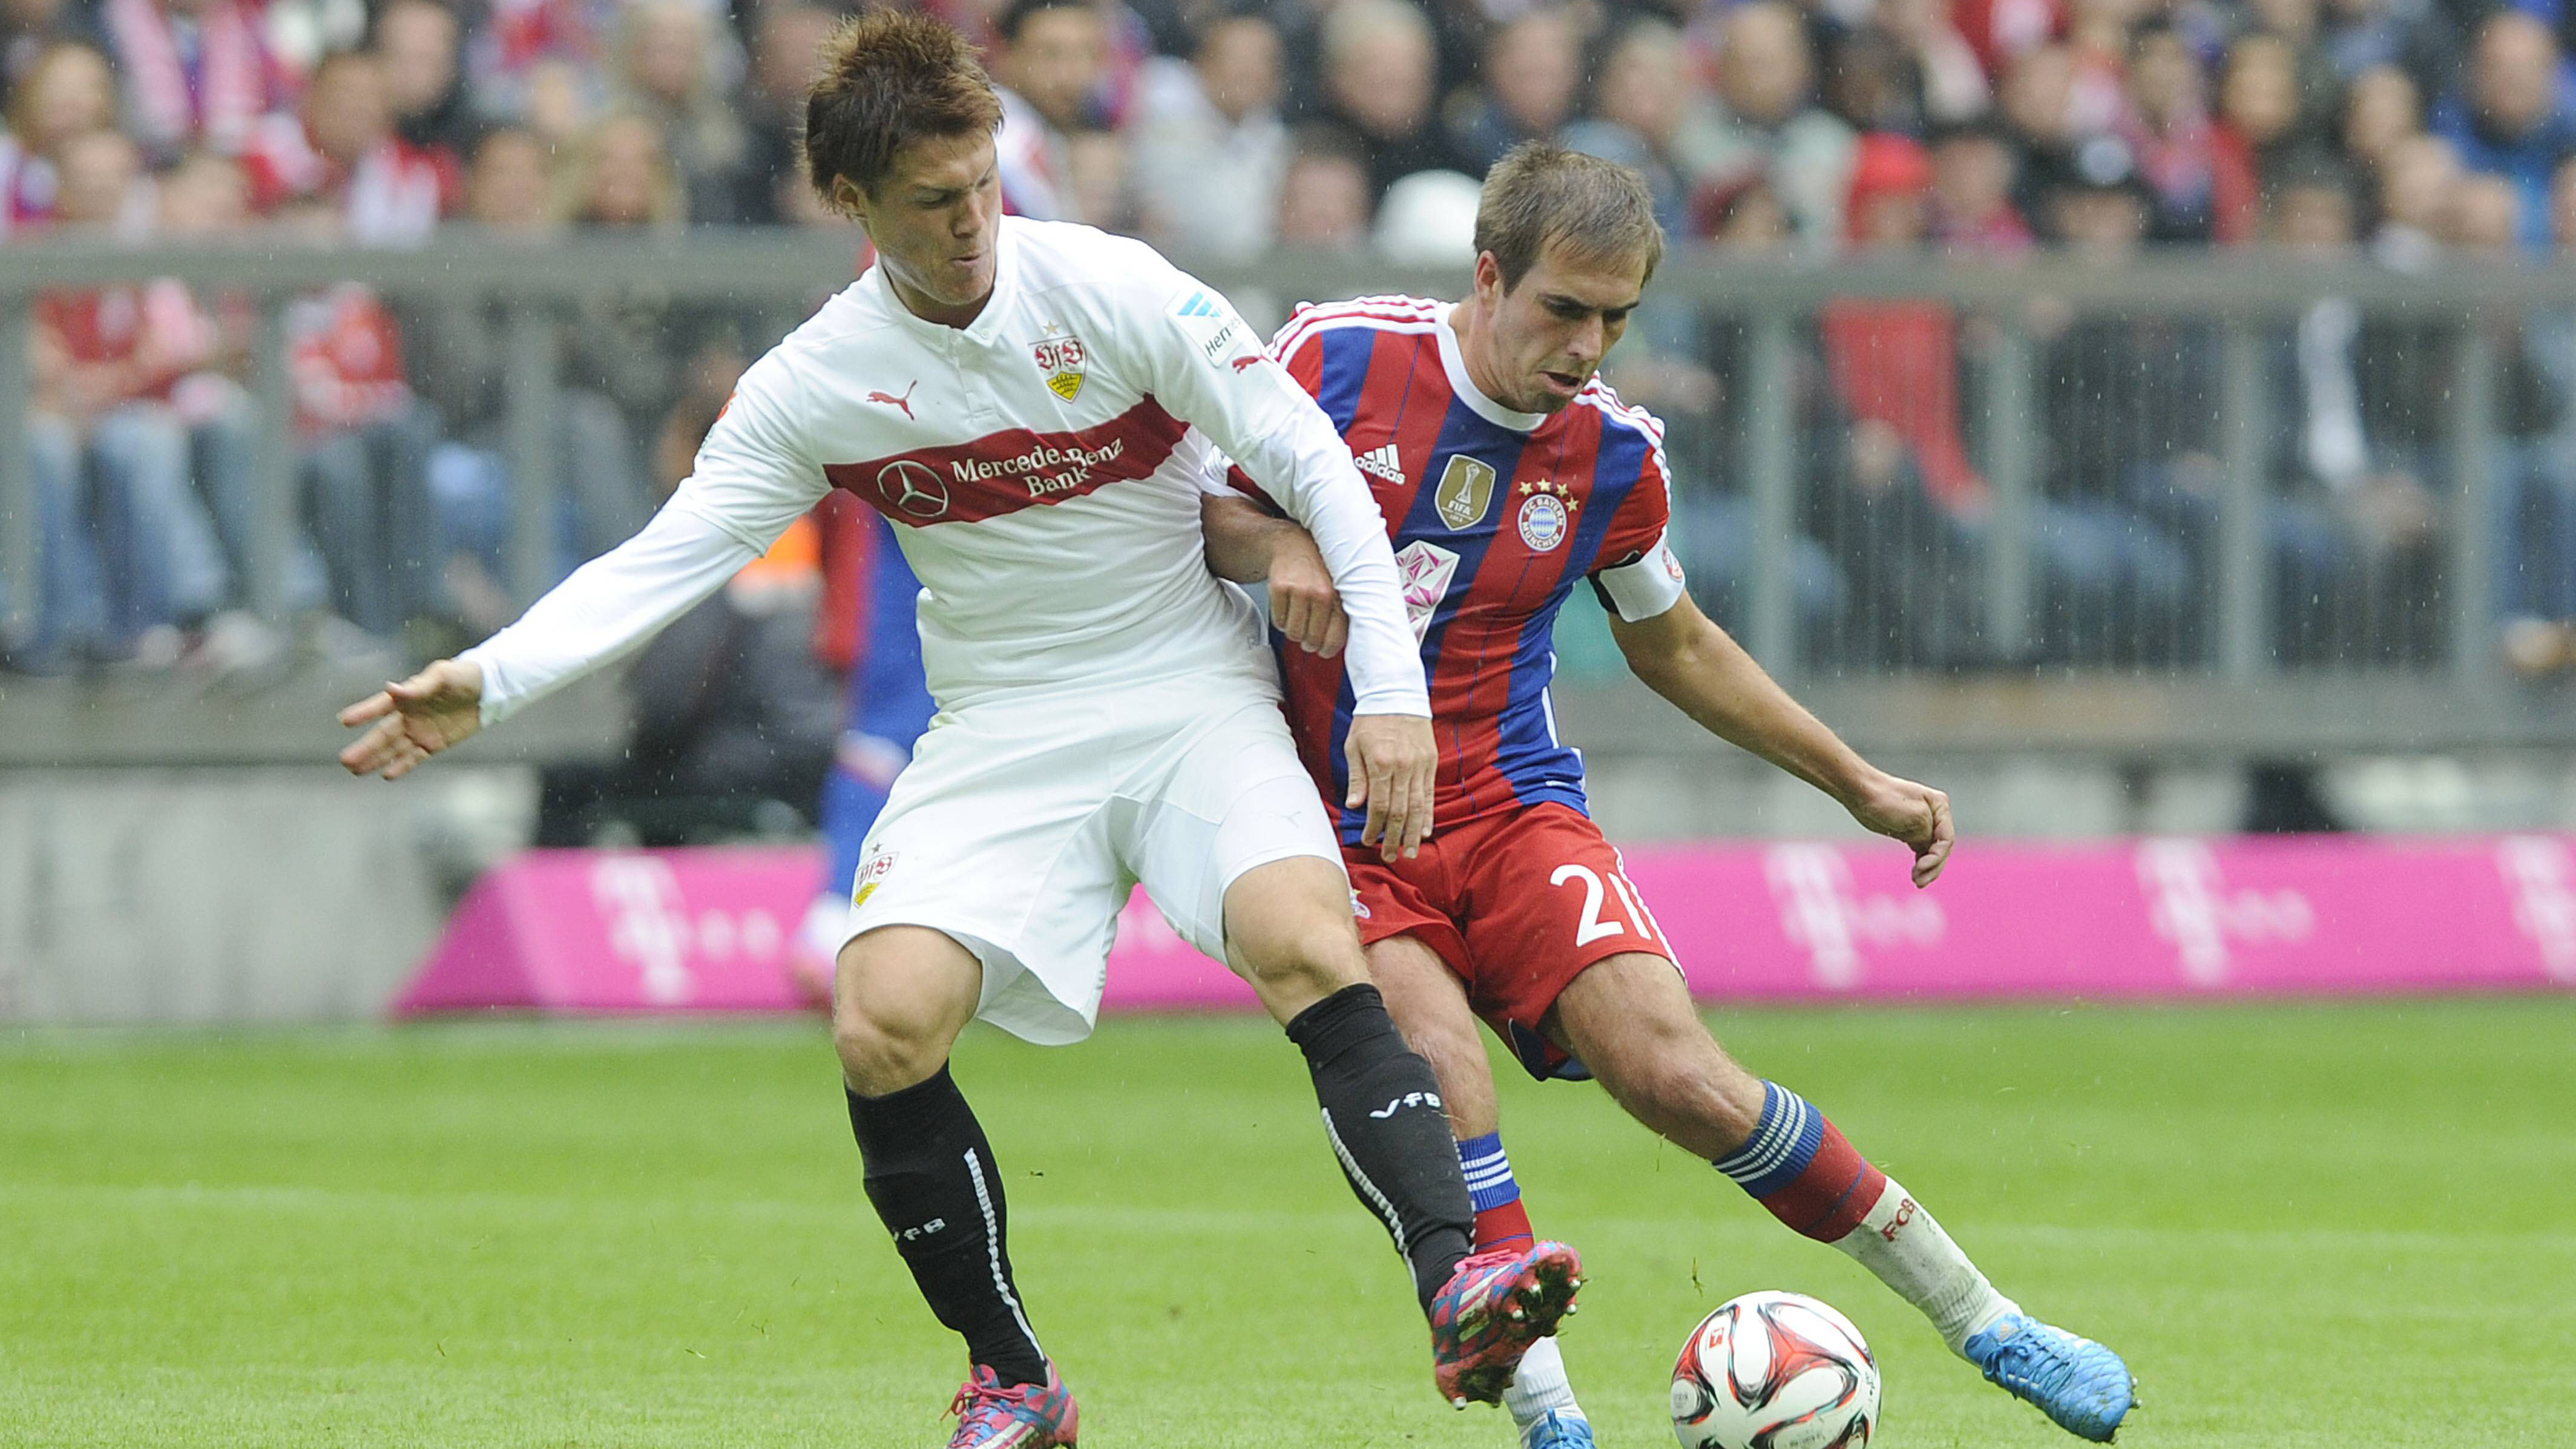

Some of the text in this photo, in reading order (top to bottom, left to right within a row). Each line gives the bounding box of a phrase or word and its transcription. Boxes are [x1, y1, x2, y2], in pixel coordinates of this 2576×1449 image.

[950, 438, 1123, 482] Mercede-Benz
[1355, 456, 1406, 485] adidas
[1023, 466, 1092, 498] Bank
[1448, 500, 1471, 516] FIFA
[1549, 864, 1652, 947] 21
[1880, 1198, 1916, 1243] FCB
